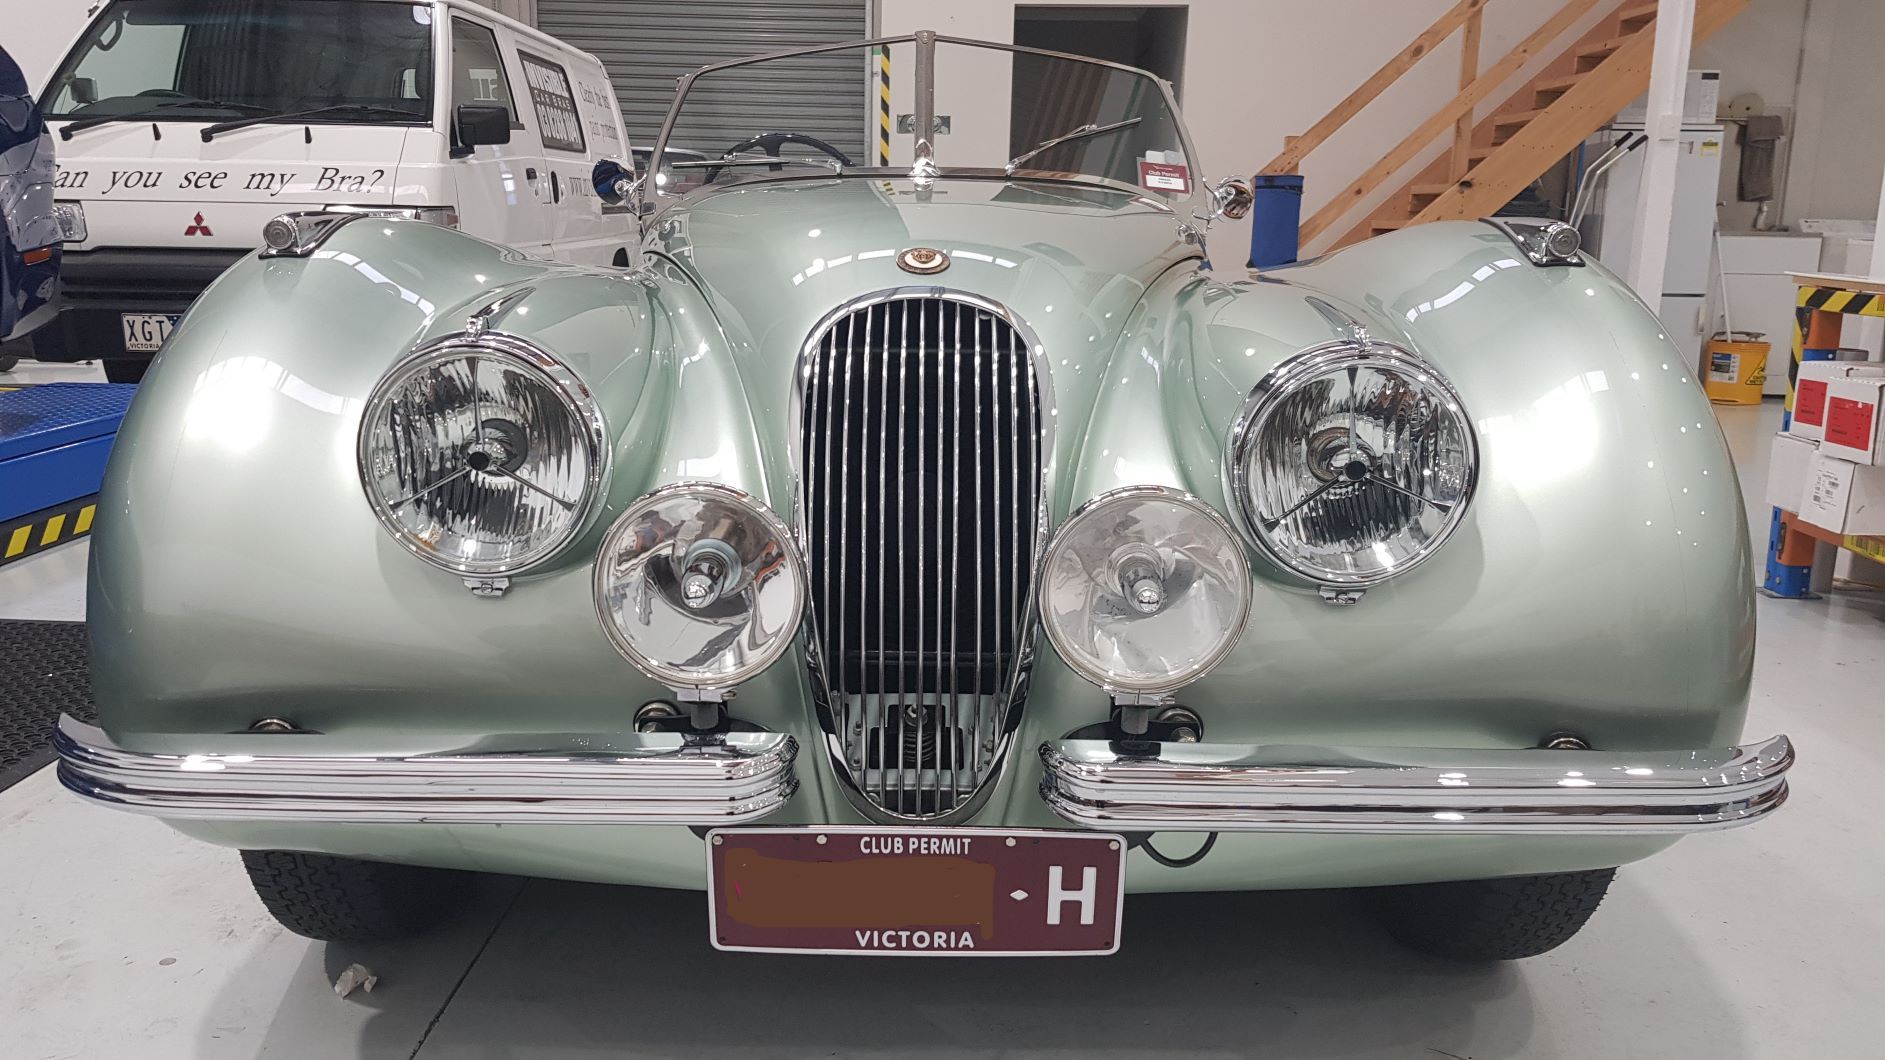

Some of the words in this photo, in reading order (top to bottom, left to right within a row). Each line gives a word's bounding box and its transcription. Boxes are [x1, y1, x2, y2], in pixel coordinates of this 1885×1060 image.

[101, 170, 163, 195] you
[178, 170, 228, 189] see
[243, 171, 297, 197] my
[310, 166, 385, 194] Bra?
[126, 319, 165, 342] XGT
[129, 342, 160, 350] VICTORIA
[859, 836, 904, 855] CLUB
[908, 837, 972, 856] PERMIT
[1046, 865, 1097, 925] H
[854, 929, 975, 949] VICTORIA
